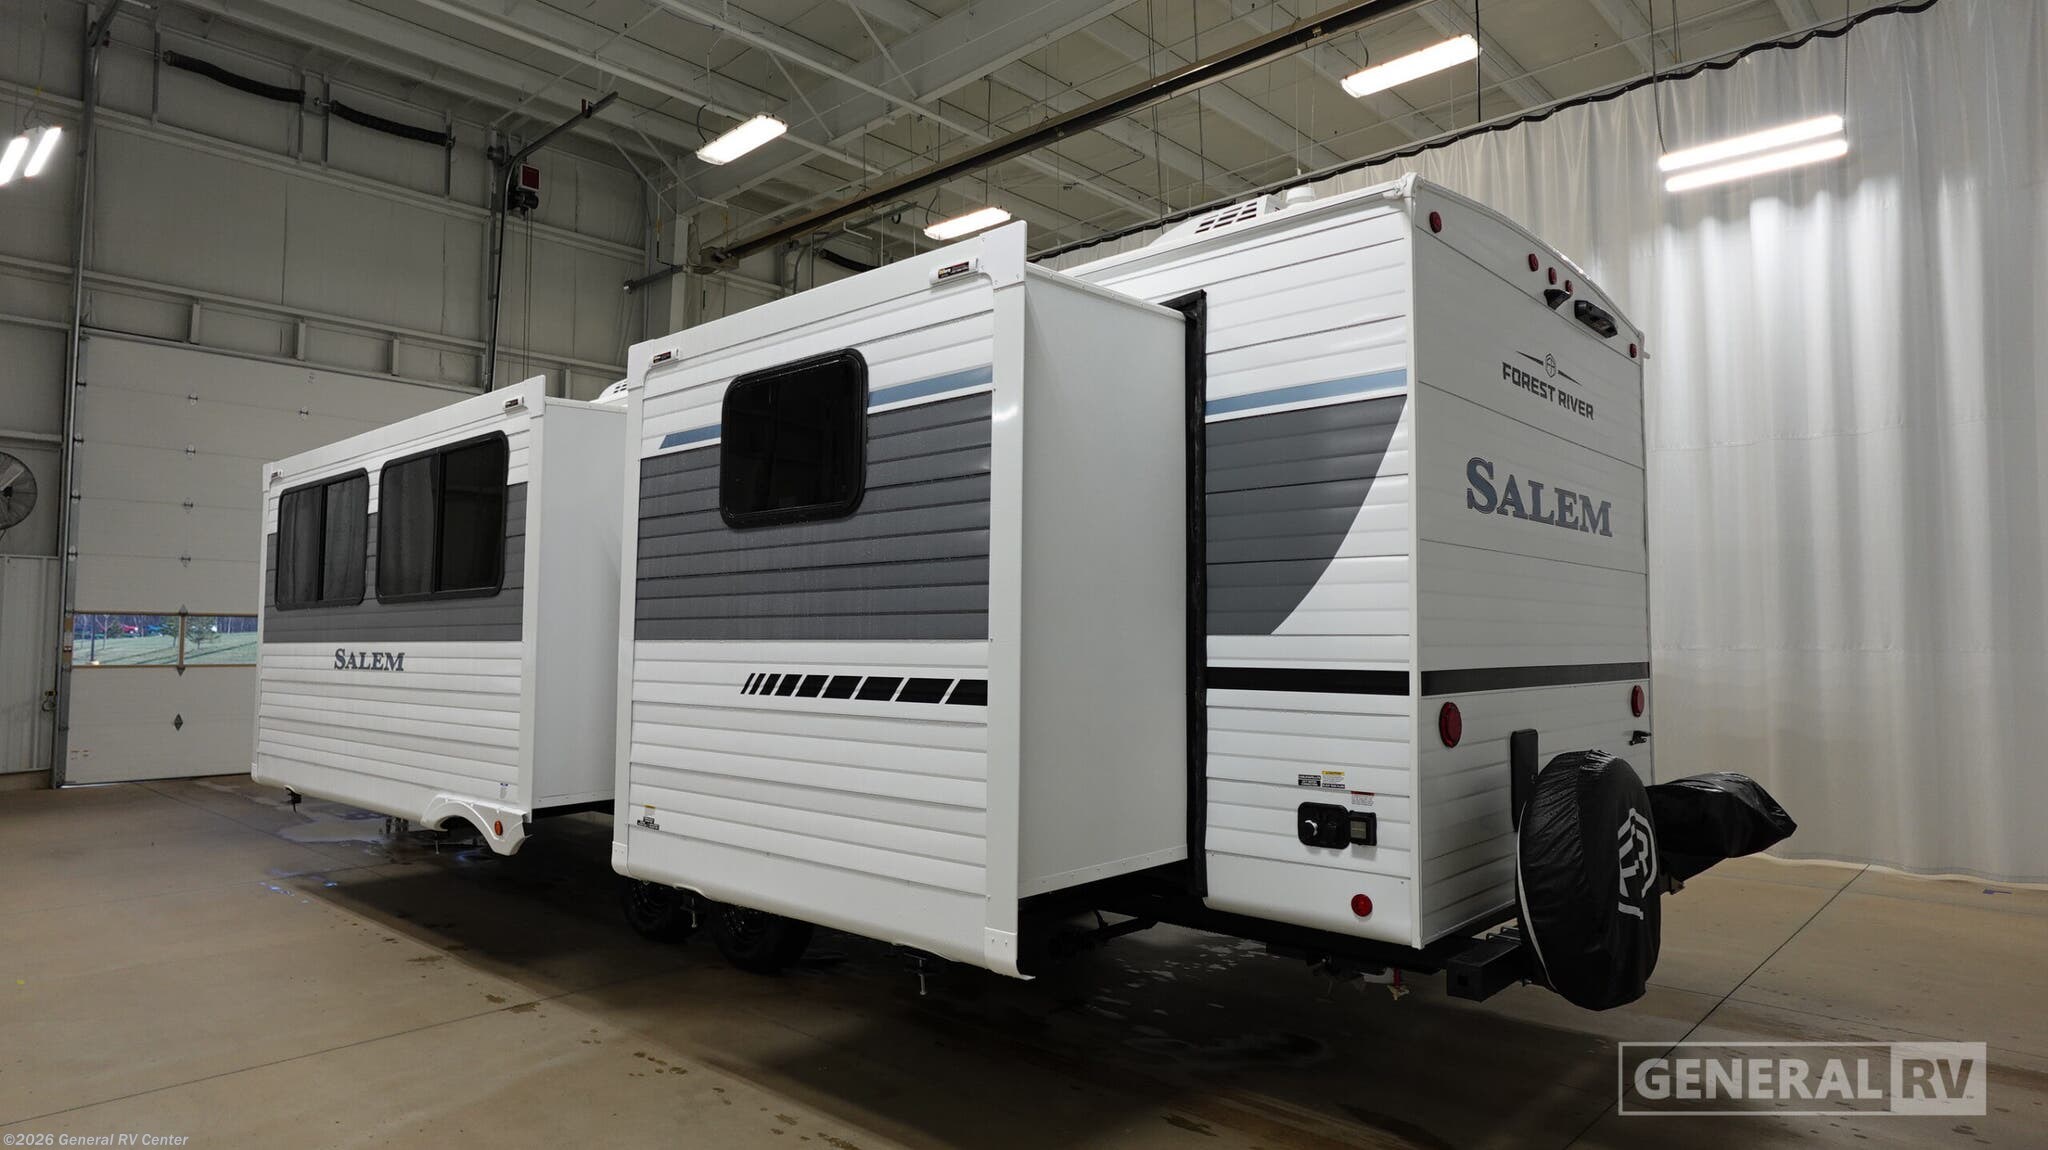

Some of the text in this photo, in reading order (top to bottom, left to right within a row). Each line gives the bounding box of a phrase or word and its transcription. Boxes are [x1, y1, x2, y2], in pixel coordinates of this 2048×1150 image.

[1502, 361, 1594, 420] FOREST RIVER
[1466, 456, 1613, 538] SALEM
[334, 648, 405, 671] SALEM
